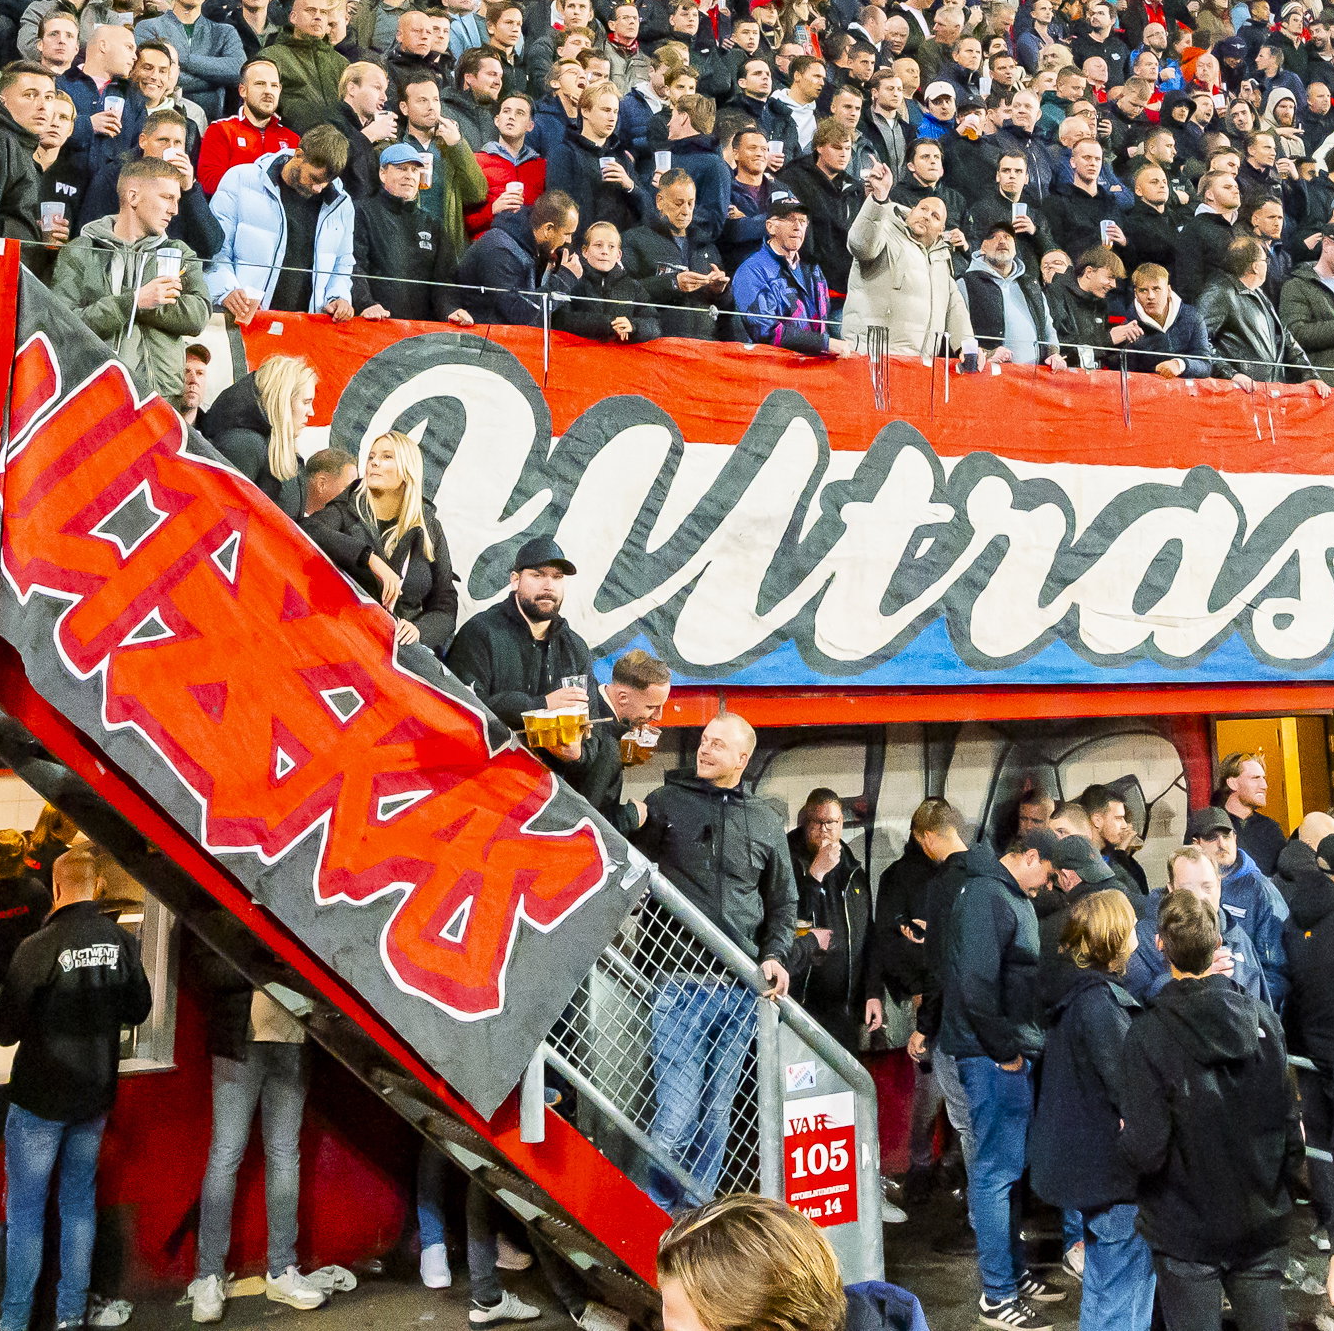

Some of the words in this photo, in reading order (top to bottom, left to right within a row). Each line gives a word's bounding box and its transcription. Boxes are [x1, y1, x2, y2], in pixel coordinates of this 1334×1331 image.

[55, 181, 78, 197] PVP
[790, 1138, 850, 1179] 105
[824, 1197, 843, 1216] 14
